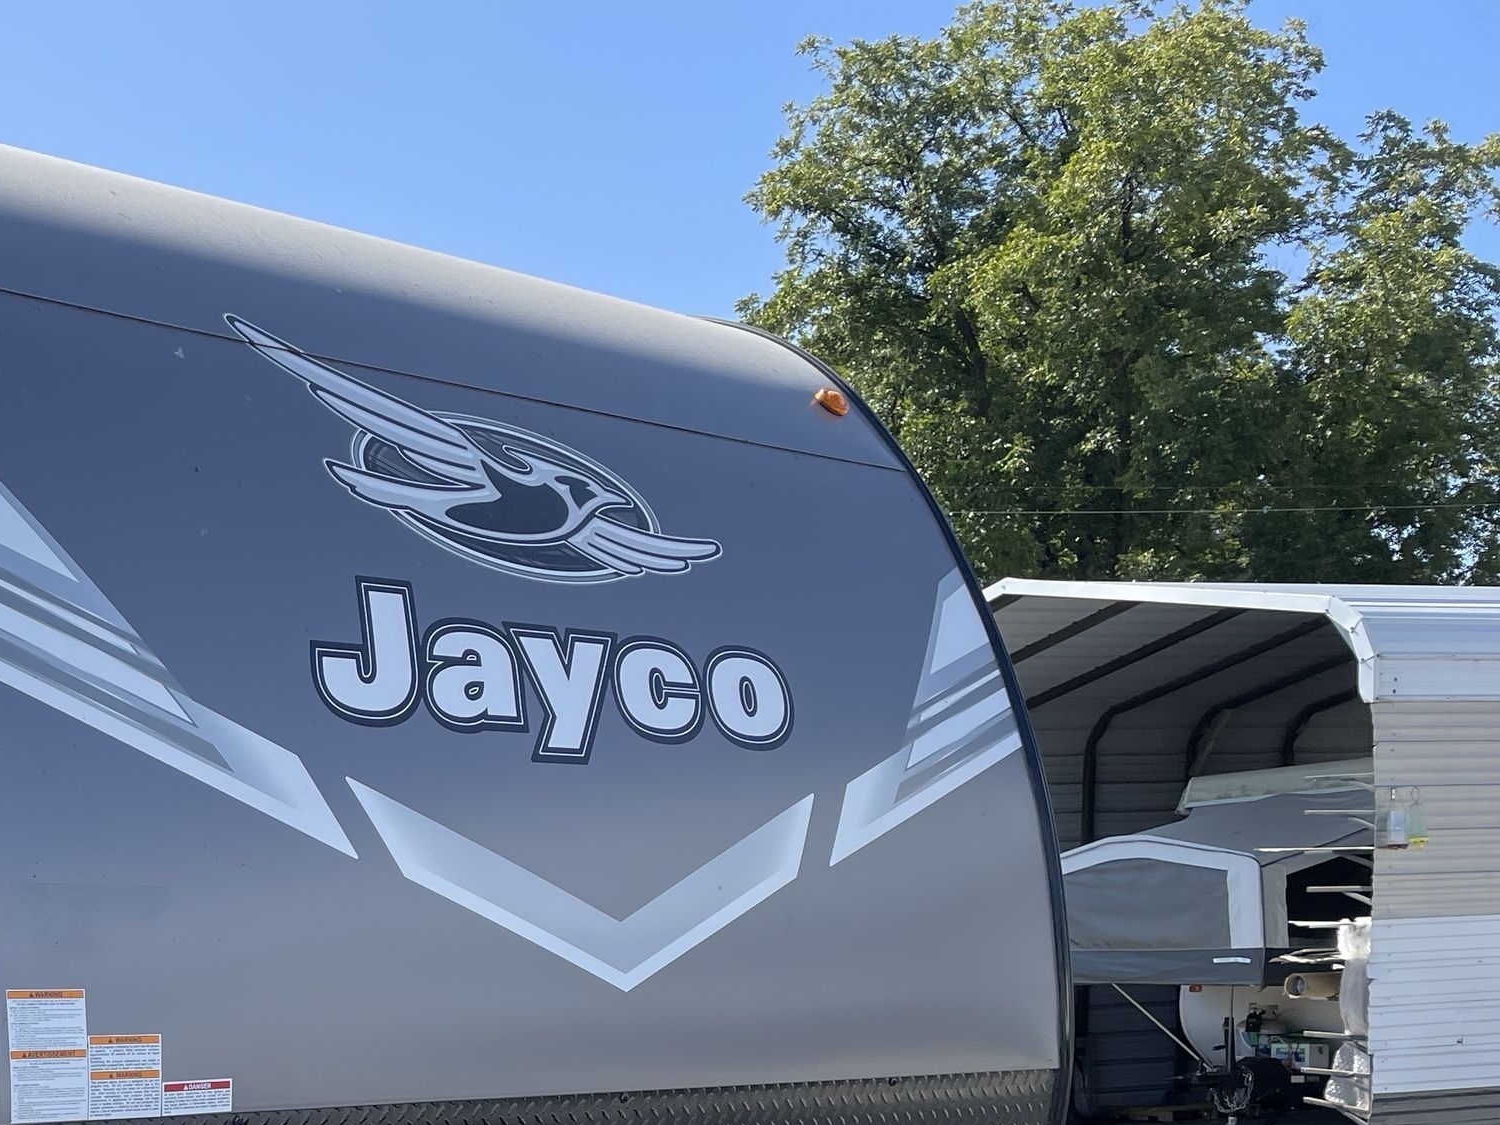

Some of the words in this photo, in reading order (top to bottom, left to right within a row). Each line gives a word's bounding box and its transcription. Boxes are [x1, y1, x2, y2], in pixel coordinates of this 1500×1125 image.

[309, 575, 795, 765] Jayco
[34, 991, 63, 999] WARNING
[188, 1082, 212, 1090] DANGER
